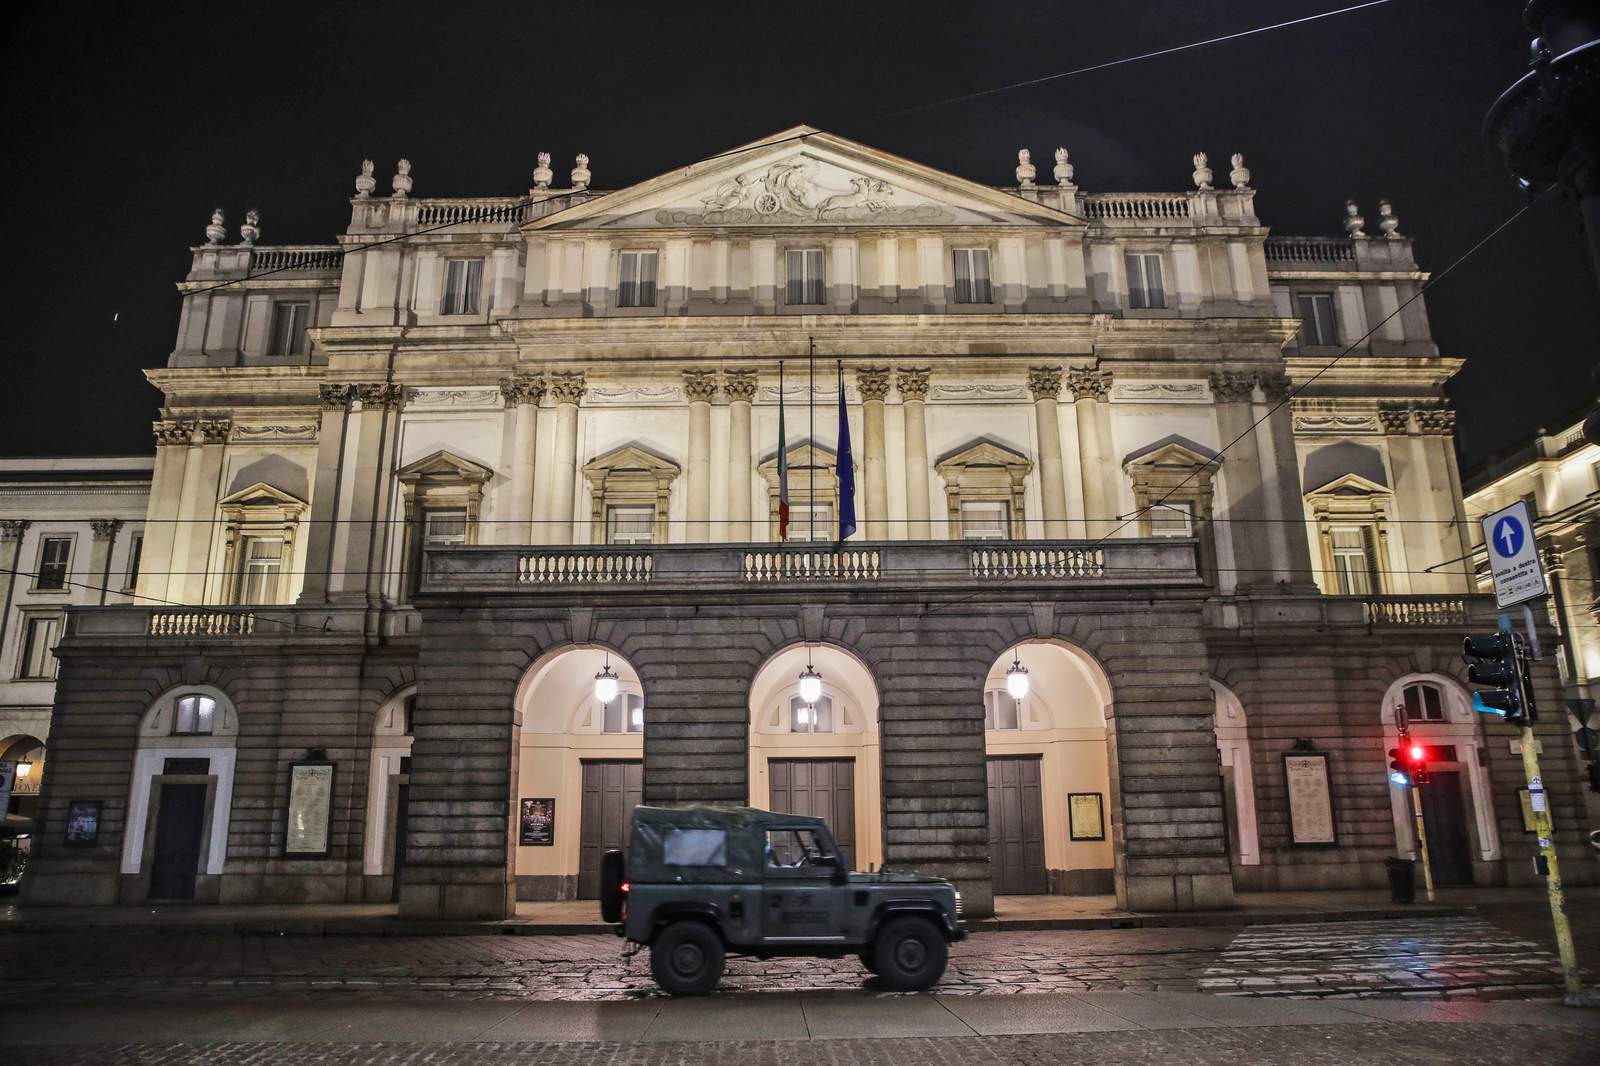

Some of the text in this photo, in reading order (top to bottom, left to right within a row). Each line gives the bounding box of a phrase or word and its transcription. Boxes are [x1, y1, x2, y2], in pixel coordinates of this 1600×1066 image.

[1495, 568, 1511, 578] svolta
[1518, 559, 1536, 569] destra
[1500, 571, 1528, 584] consentita
